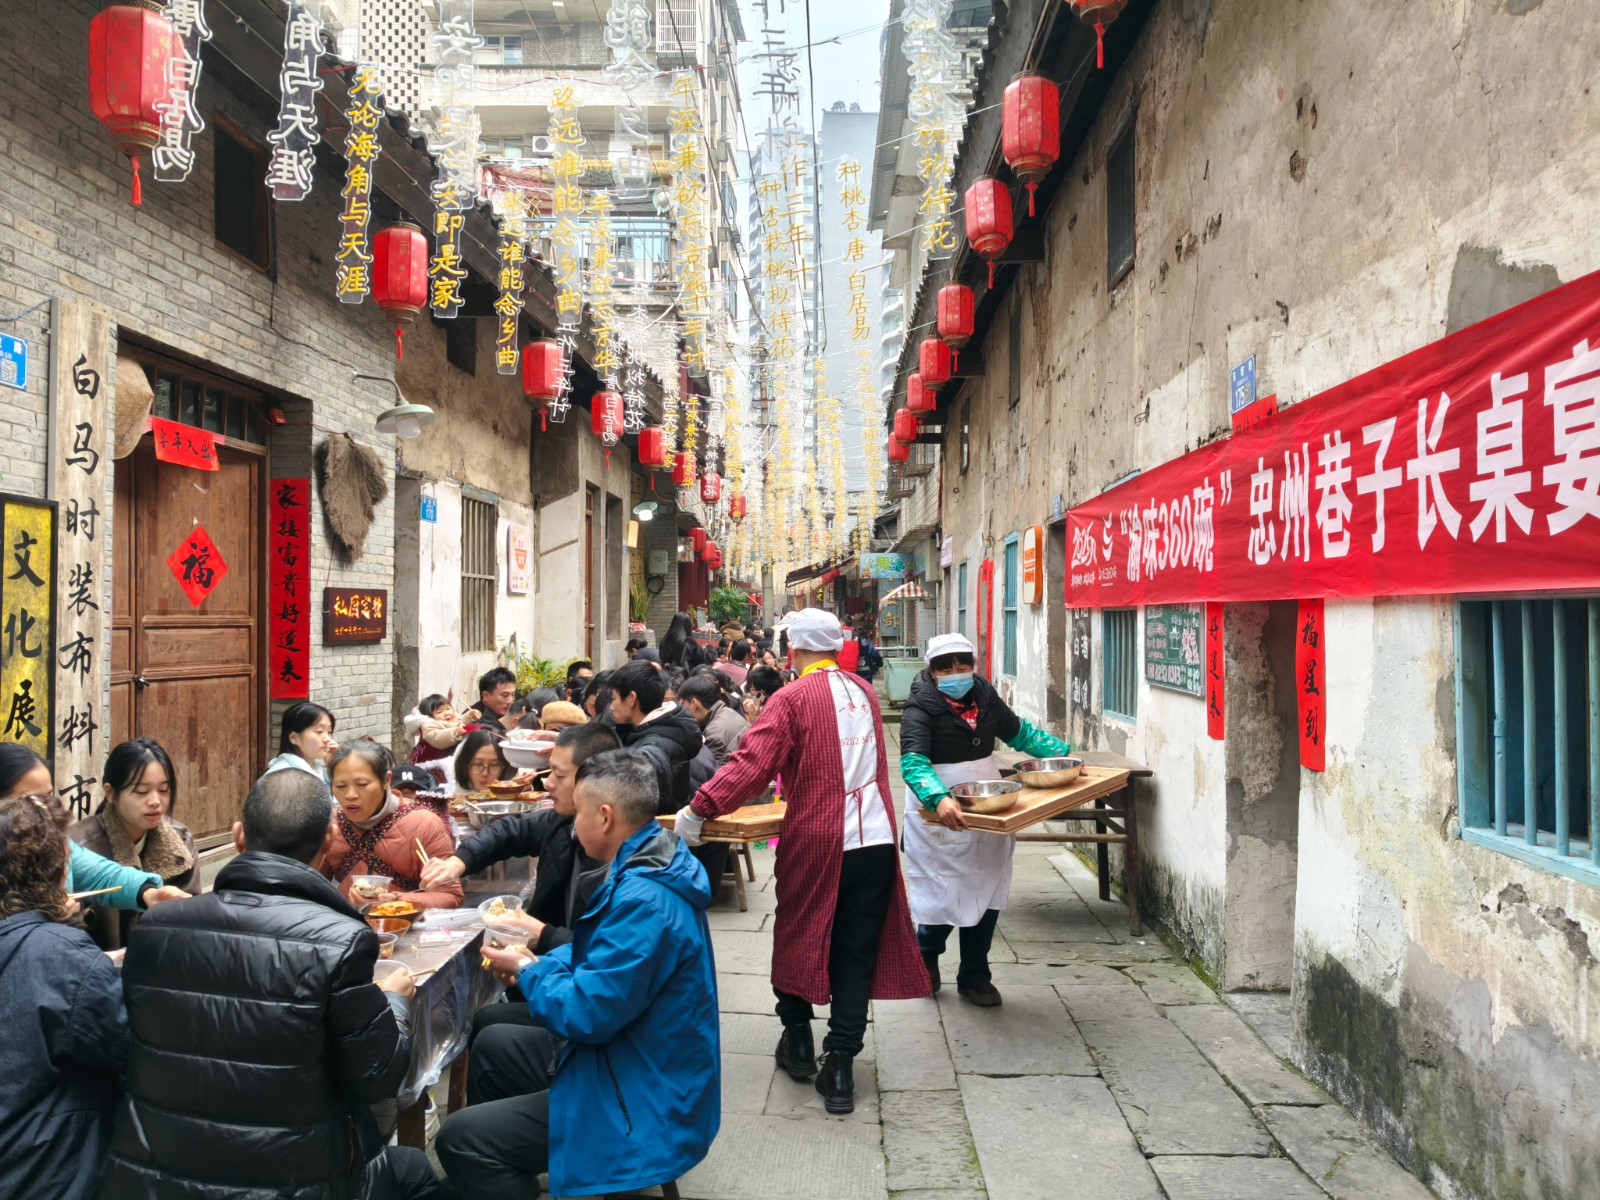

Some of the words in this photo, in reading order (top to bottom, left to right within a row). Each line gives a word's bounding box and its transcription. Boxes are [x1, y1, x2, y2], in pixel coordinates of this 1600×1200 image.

[338, 66, 382, 296] 无论海角与天涯
[550, 85, 584, 315] 路远谁能念乡曲
[759, 178, 795, 360] 种杏栽桃拟待花
[838, 160, 873, 341] 种桃杏唐白居易
[495, 192, 527, 368] 路远谁能念乡曲
[1248, 338, 1600, 565] 忠州巷子长桌宴
[180, 542, 215, 589] 福
[401, 771, 413, 781] H
